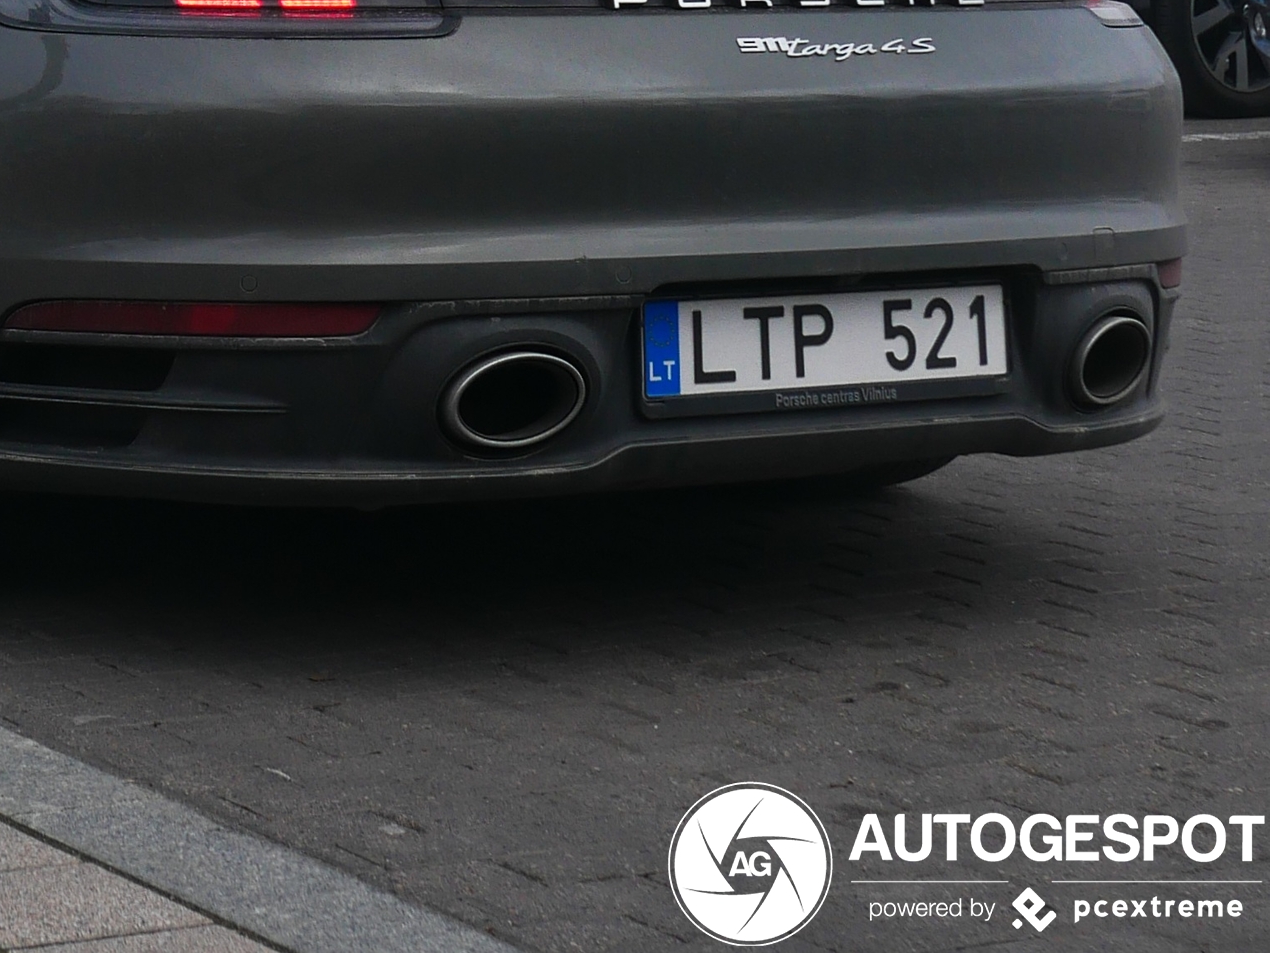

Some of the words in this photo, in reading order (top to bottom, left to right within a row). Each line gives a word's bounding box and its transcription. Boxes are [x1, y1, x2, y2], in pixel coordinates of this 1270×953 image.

[692, 304, 834, 384] LTP
[883, 295, 988, 372] 521
[649, 360, 675, 382] LT
[776, 392, 819, 407] Porsche
[820, 390, 859, 405] centras
[861, 387, 898, 402] Vilnius
